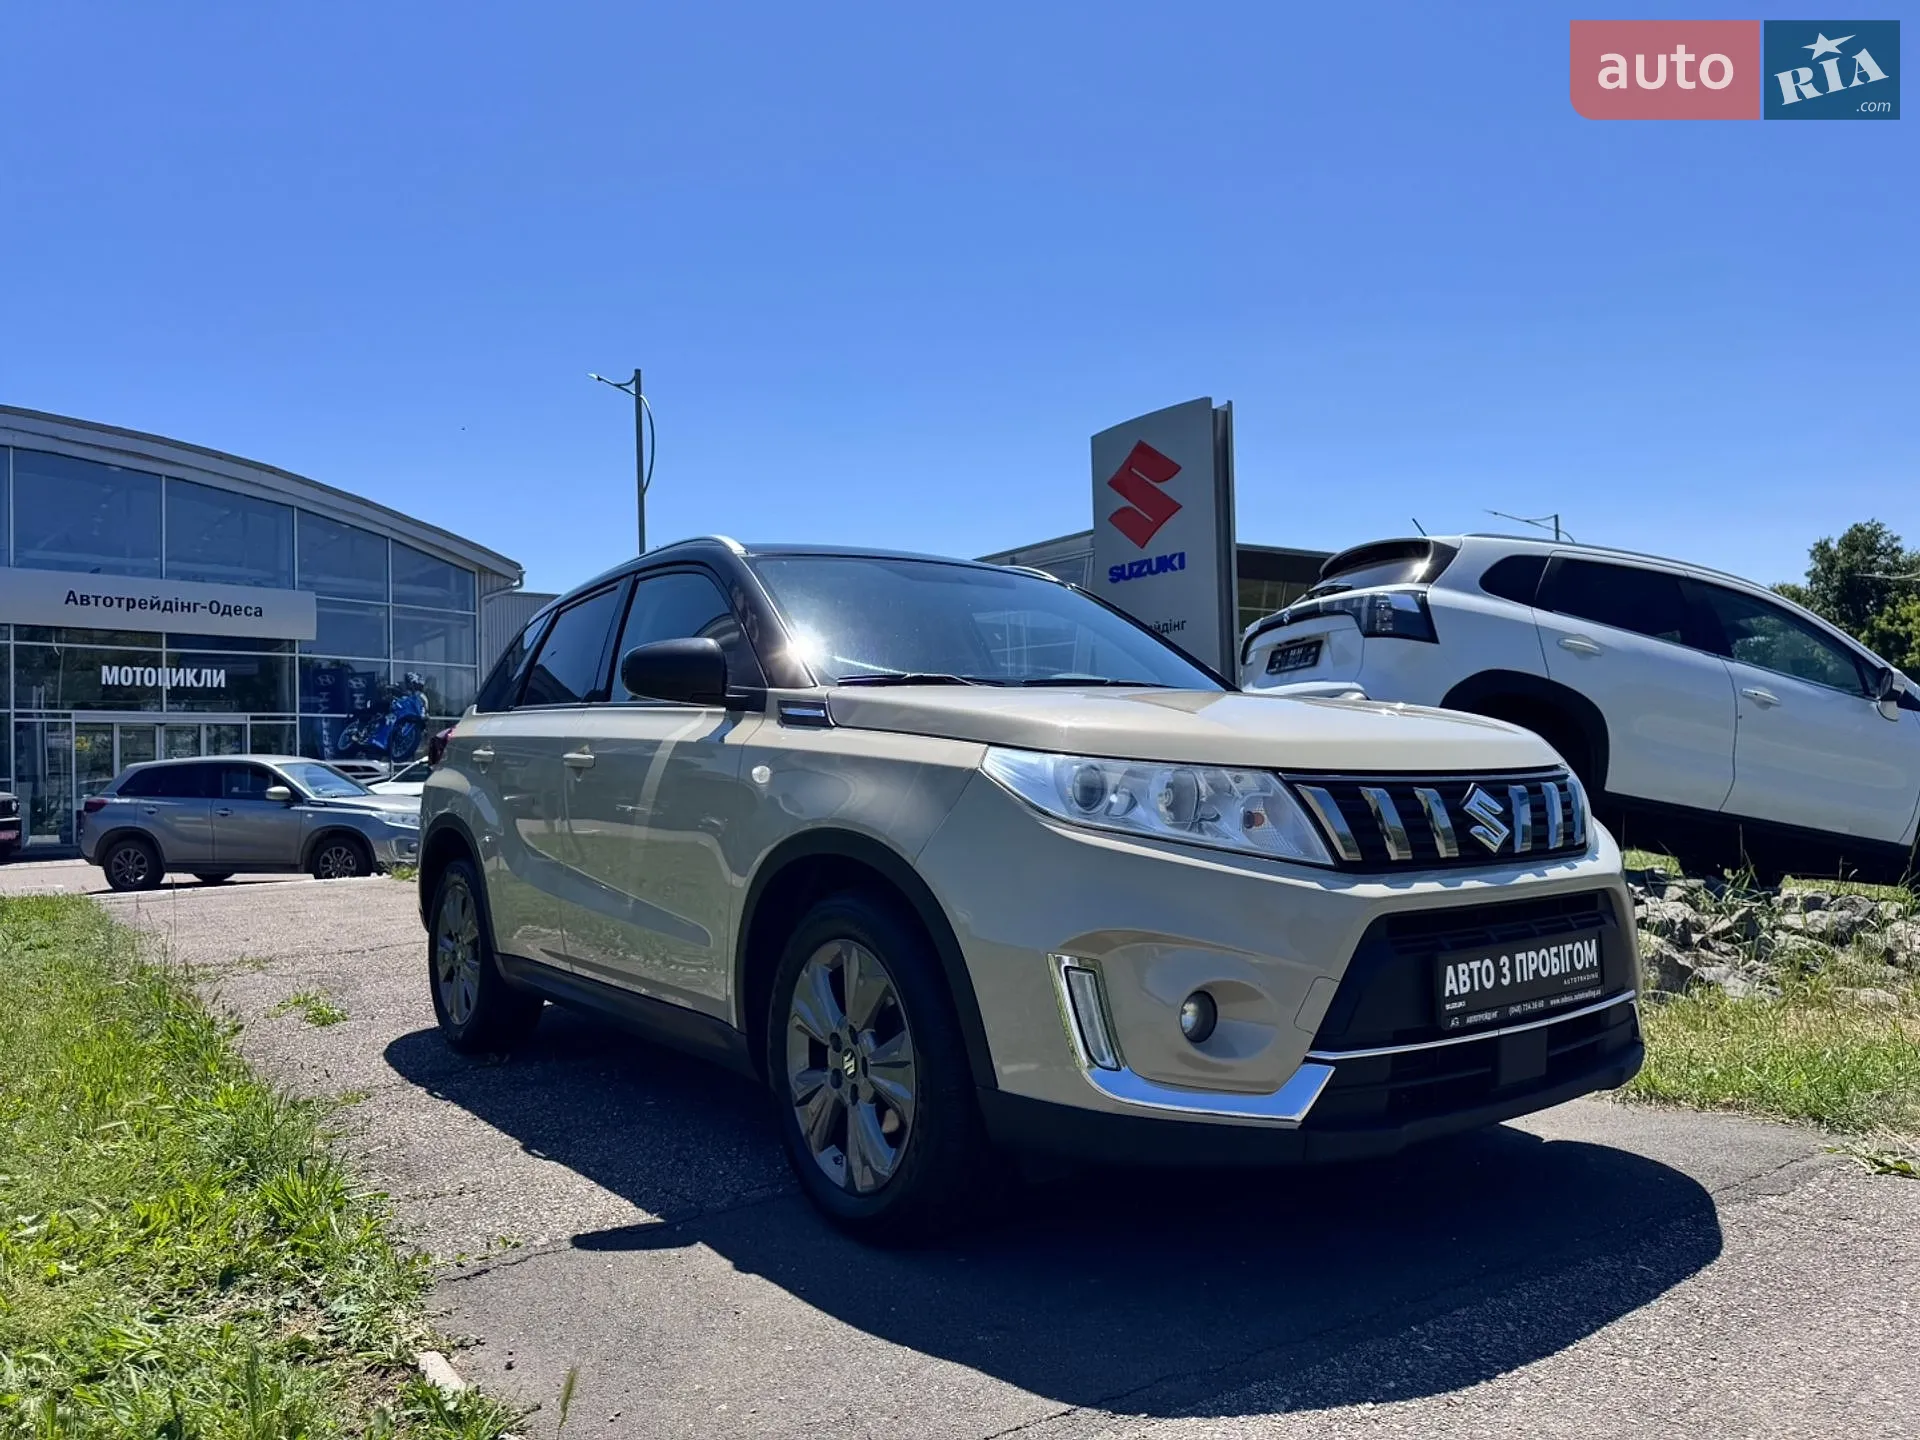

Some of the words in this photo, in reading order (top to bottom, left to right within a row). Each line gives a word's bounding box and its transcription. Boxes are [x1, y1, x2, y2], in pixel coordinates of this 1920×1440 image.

[1108, 551, 1186, 584] SUZUKI
[64, 589, 264, 619] Автотрейдінг-Одеса
[101, 665, 227, 690] МОТОЦИКЛИ
[1444, 958, 1495, 997] АВТО
[1515, 939, 1598, 983] ПРОБІГОМ
